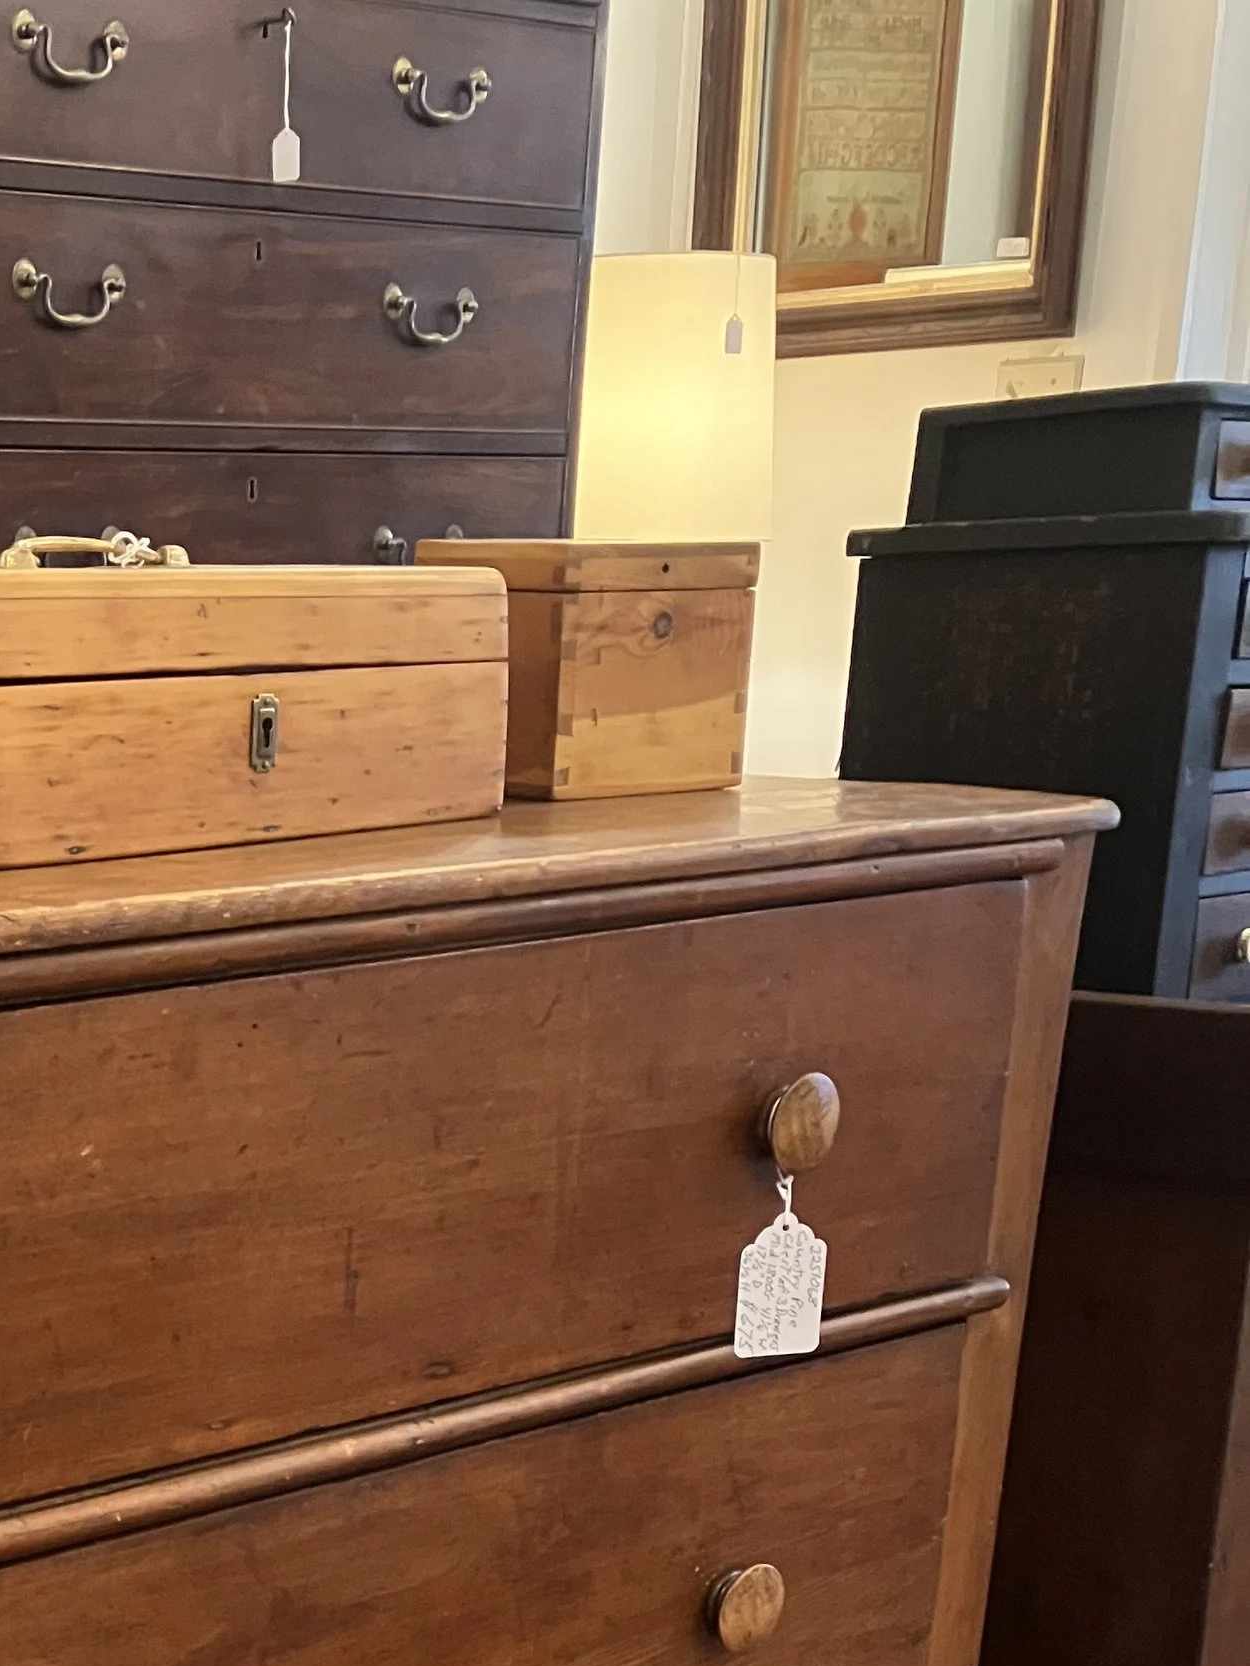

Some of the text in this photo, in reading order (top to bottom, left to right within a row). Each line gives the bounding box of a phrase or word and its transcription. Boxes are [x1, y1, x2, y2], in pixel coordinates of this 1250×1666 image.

[780, 1233, 793, 1276] Chest
[776, 1296, 788, 1306] 3
[784, 1231, 809, 1328] Country Pine
